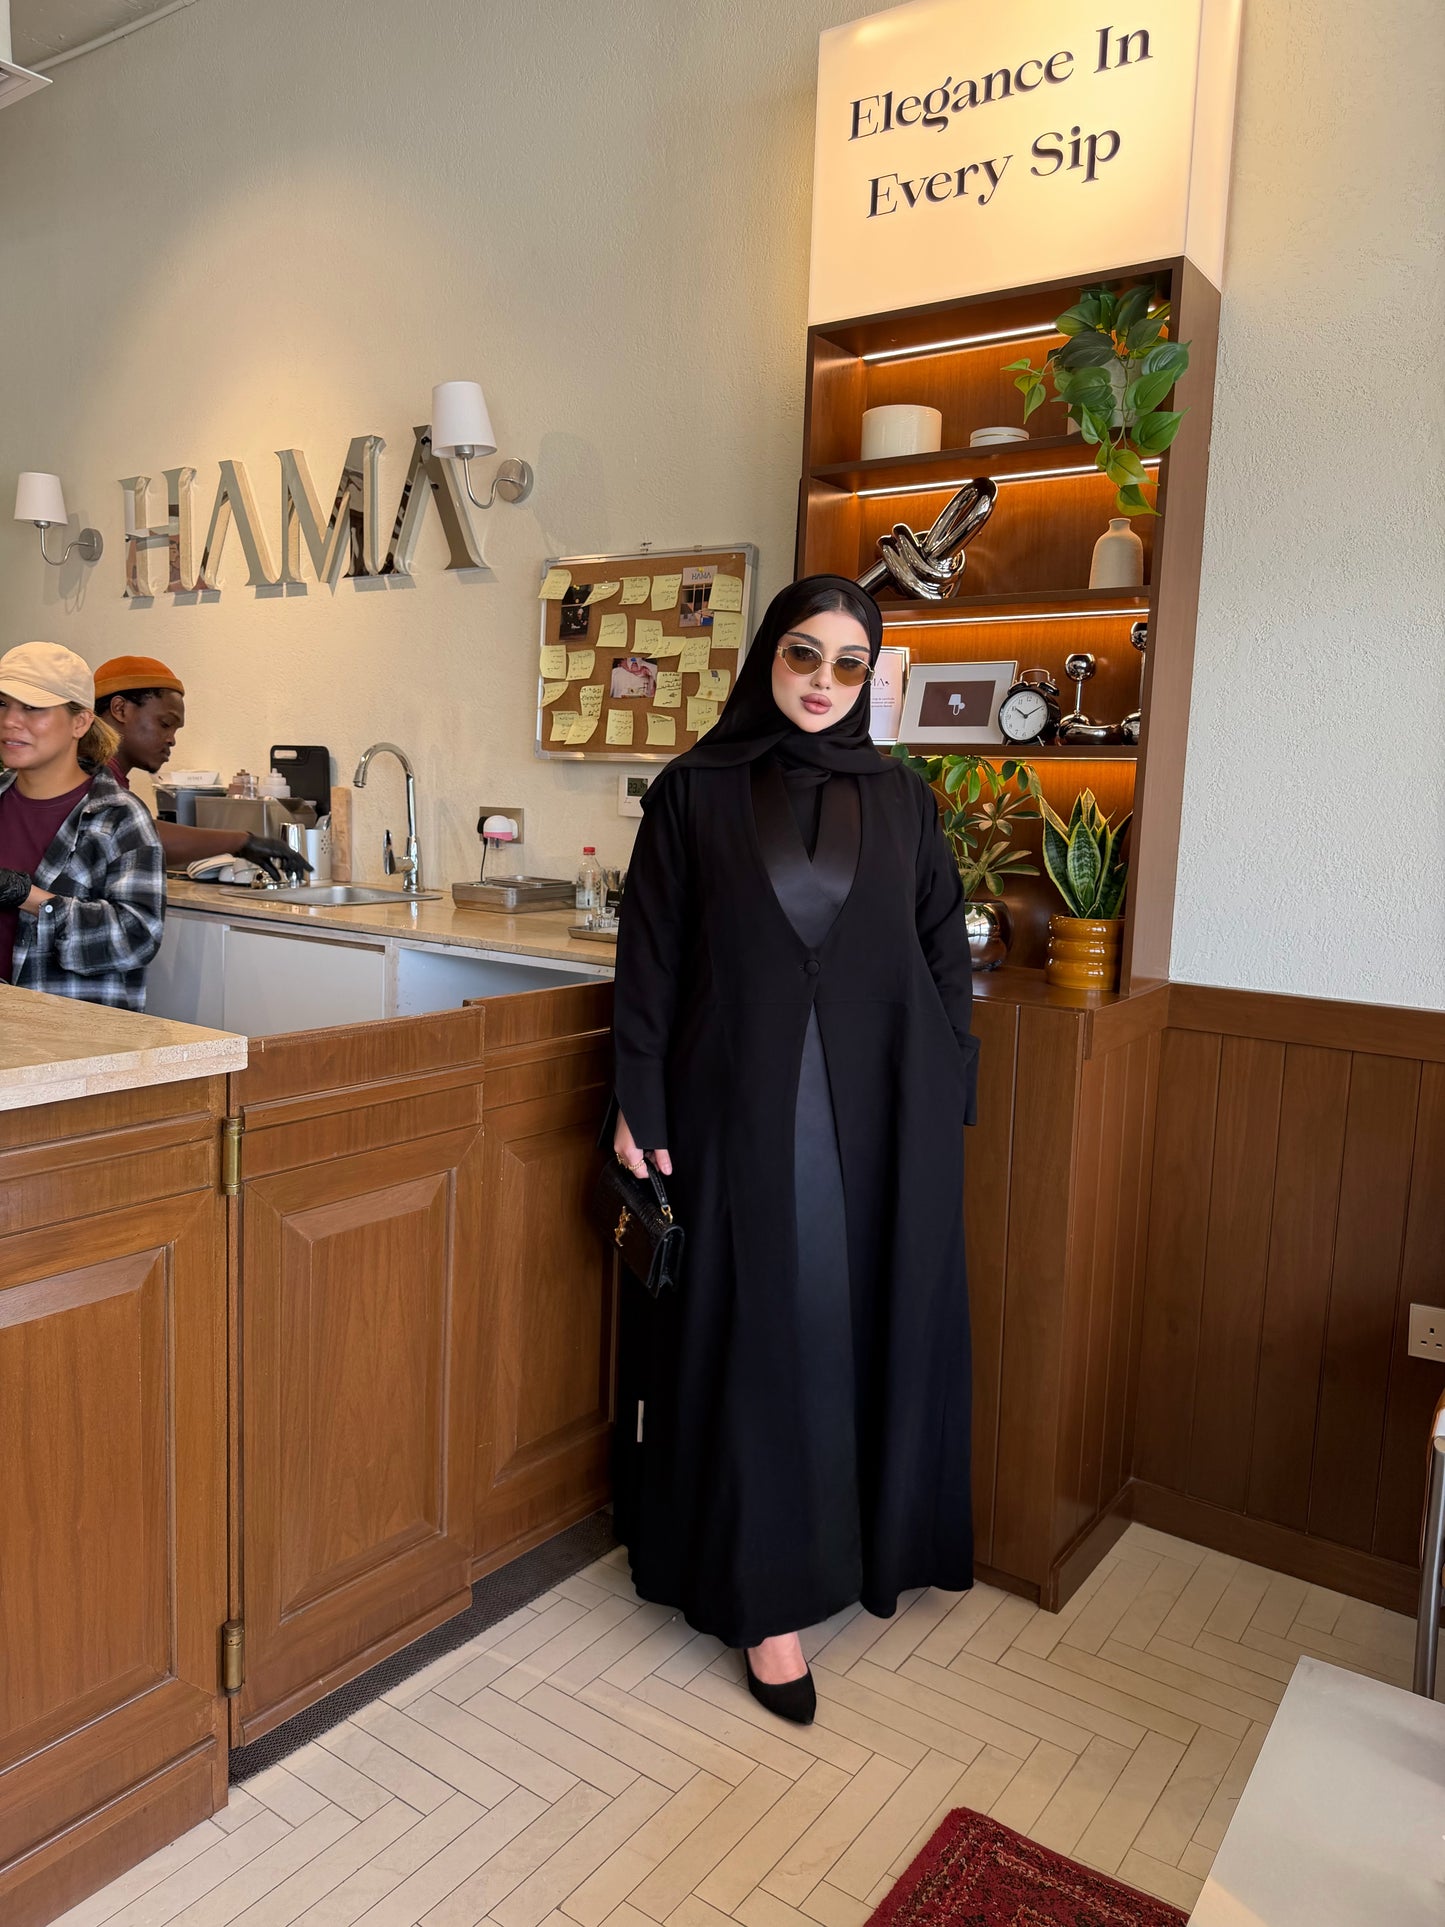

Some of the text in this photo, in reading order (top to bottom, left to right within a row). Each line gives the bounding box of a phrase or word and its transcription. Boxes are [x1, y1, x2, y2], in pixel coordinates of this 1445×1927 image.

[848, 25, 1154, 142] Elegance In
[866, 125, 1121, 219] Every Sip
[118, 424, 491, 598] HAMA
[691, 571, 712, 580] HAMA
